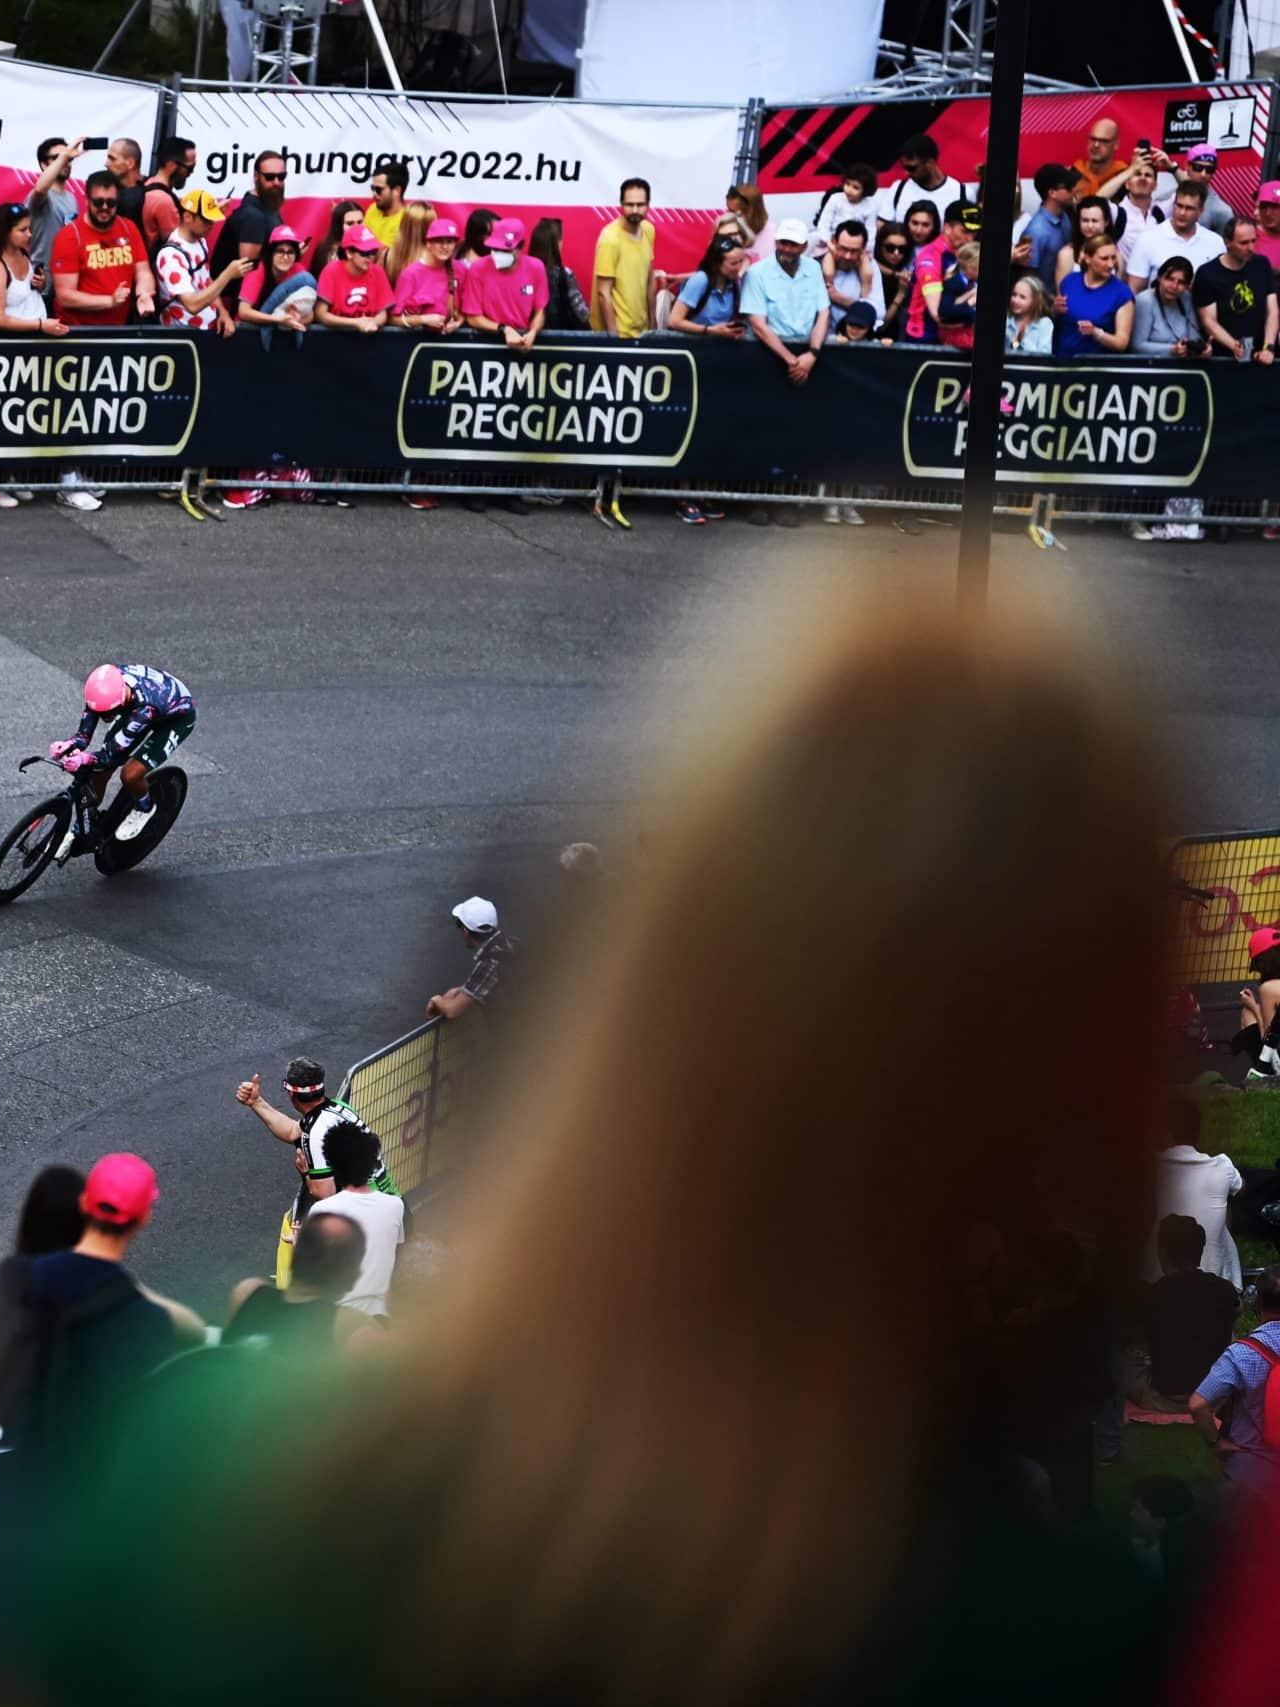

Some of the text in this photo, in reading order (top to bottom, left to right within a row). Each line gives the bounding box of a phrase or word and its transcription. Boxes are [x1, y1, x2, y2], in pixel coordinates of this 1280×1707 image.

[206, 143, 582, 186] girhungary2022.hu
[87, 245, 133, 269] 49ERS
[429, 360, 672, 403] PARMIGIANO
[446, 403, 644, 444] REGGIANO
[954, 420, 1158, 464] GGIANO
